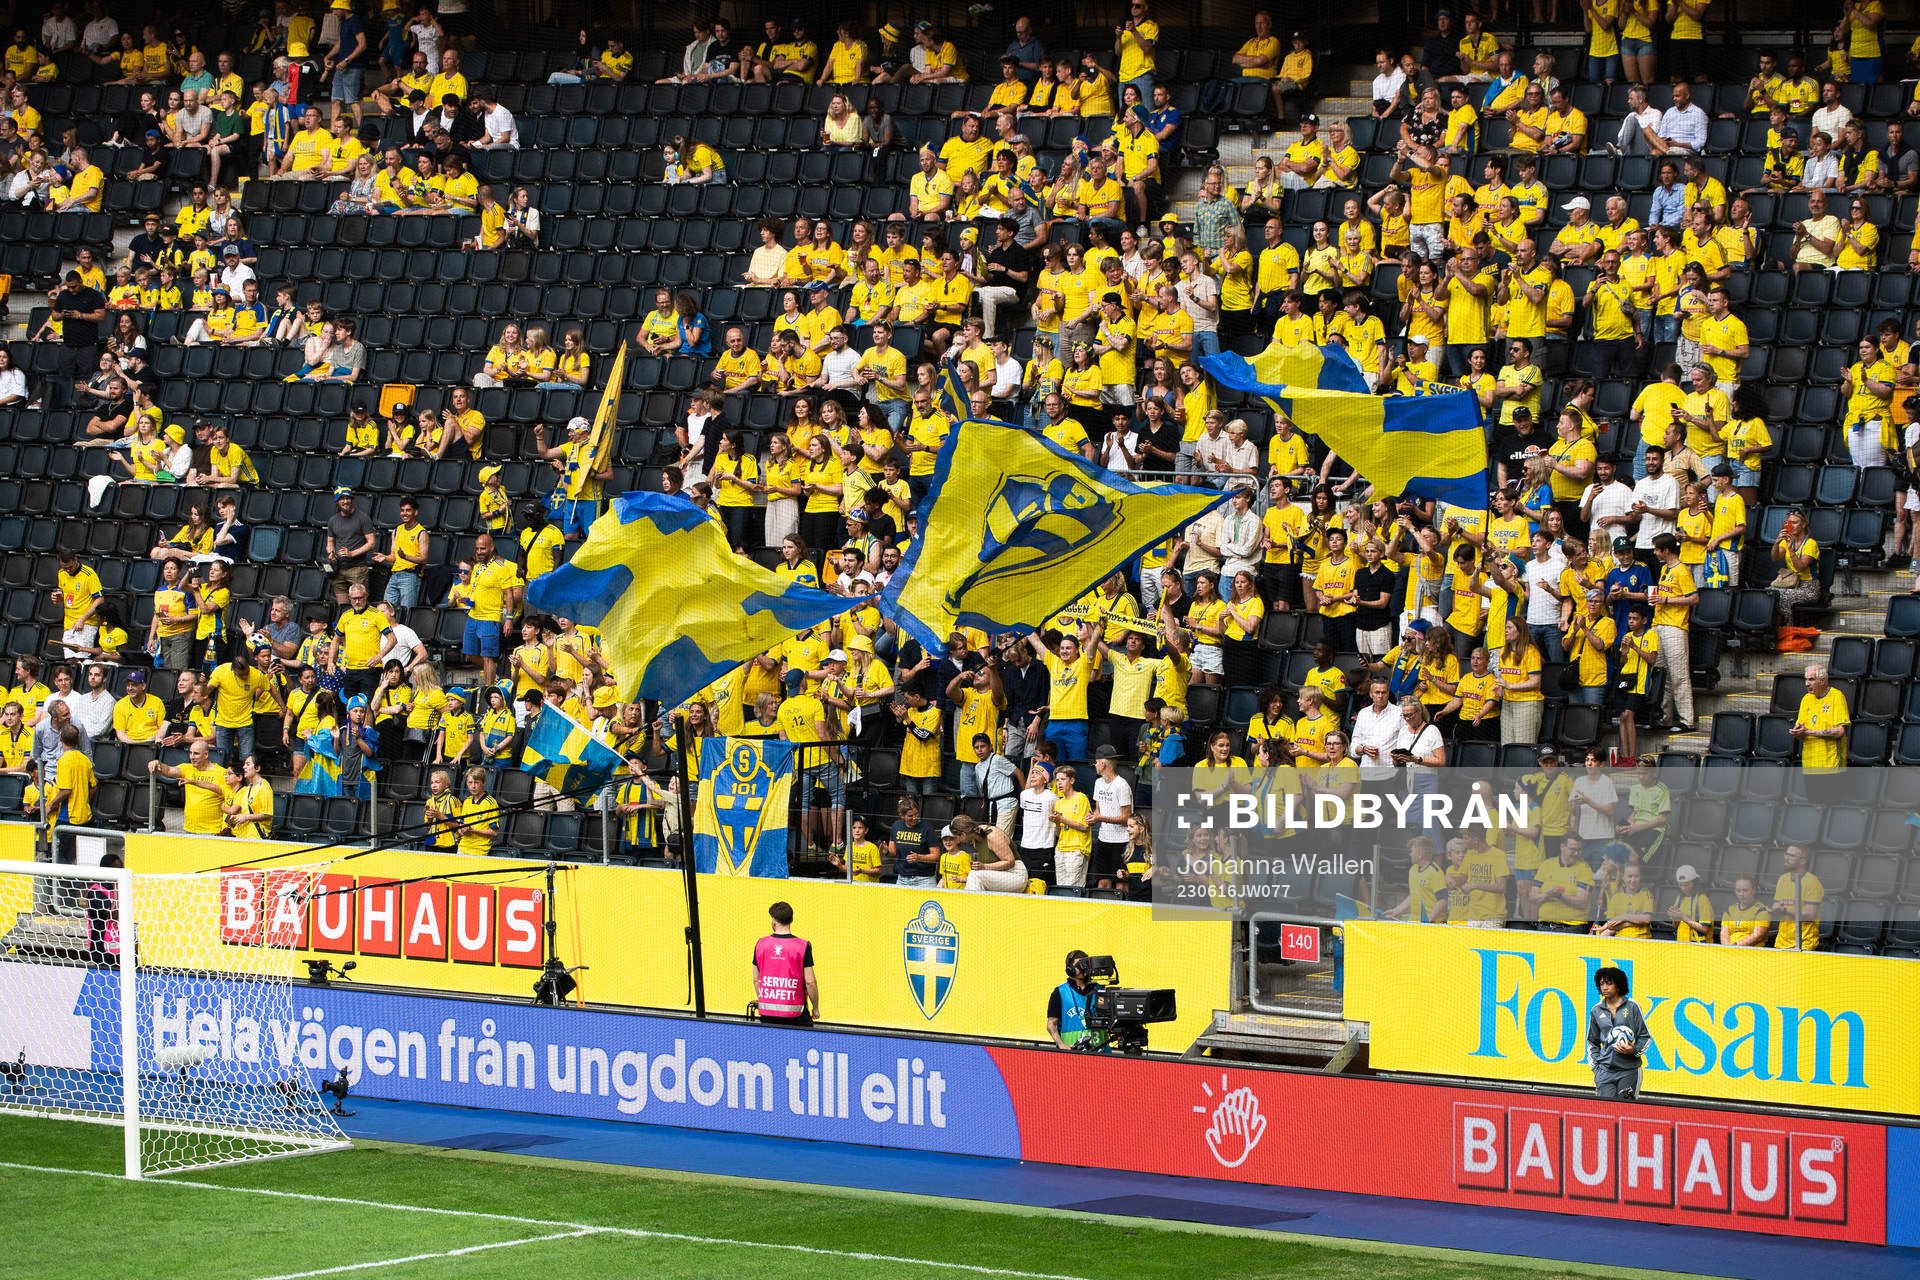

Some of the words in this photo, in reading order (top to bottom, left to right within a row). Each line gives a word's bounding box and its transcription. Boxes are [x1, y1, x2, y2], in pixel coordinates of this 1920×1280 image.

[962, 713, 976, 726] 24
[739, 749, 750, 773] S
[731, 782, 757, 795] 101
[896, 831, 923, 842] SVERIGE
[227, 878, 537, 953] BAUHAUS
[911, 934, 950, 946] SVERIGE
[1287, 932, 1313, 950] 140
[763, 976, 798, 989] SERVICE
[1468, 949, 1870, 1089] Folksam
[152, 995, 262, 1063] Hela
[269, 1006, 427, 1086] vägen
[438, 1018, 535, 1090] från
[547, 1038, 774, 1114] ungdom
[786, 1048, 849, 1119] till
[861, 1057, 947, 1129] elit
[1463, 1116, 1838, 1207] BAUHAUS
